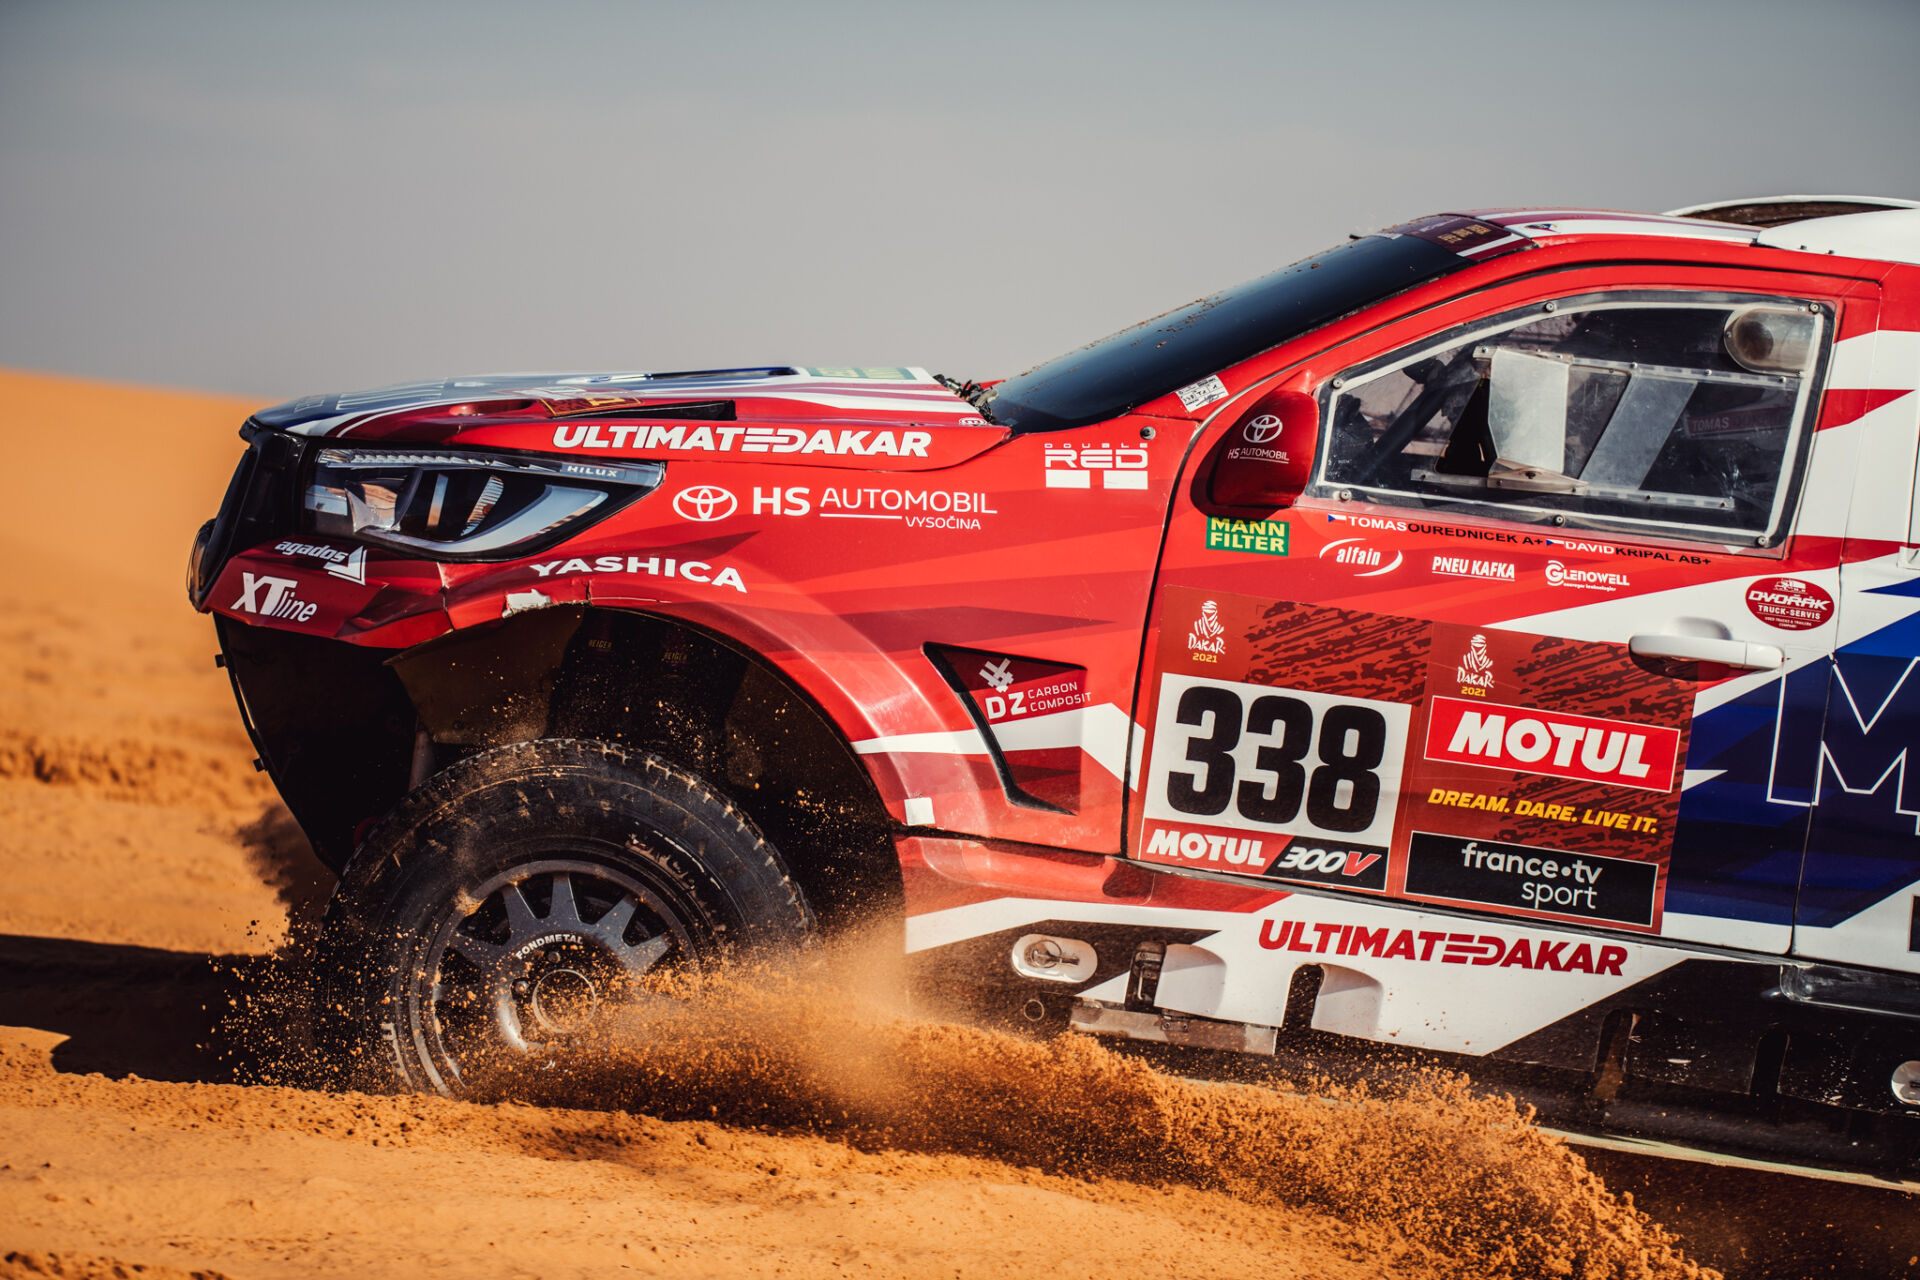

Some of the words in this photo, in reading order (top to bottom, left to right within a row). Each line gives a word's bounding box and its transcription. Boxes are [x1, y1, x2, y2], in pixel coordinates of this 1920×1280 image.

[1045, 449, 1148, 468] RED
[1228, 448, 1240, 459] HS
[1241, 447, 1290, 461] AUTOMOBIL
[567, 465, 618, 477] HILUX
[753, 487, 810, 515] HS
[820, 488, 998, 514] AUTOMOBIL
[905, 515, 981, 530] VYSOČINA
[1211, 517, 1285, 537] MANN
[1210, 532, 1285, 552] FILTER
[1522, 536, 1543, 545] A+
[275, 541, 349, 562] agados
[1336, 546, 1381, 566] alfain
[1679, 555, 1711, 565] AB+
[530, 557, 748, 594] YASHICA
[1432, 556, 1469, 574] PNEU
[1471, 560, 1515, 579] KAFKA
[1545, 562, 1630, 586] GLENOWELL
[230, 572, 318, 622] XTline
[1758, 604, 1821, 620] TRUCK-SERVIS
[1188, 632, 1226, 655] DAKAR
[1192, 652, 1218, 663] 2021
[1457, 666, 1495, 688] DAKAR
[1027, 682, 1078, 699] CARBON
[1461, 686, 1486, 697] 2021
[985, 692, 1027, 719] DZ
[1030, 692, 1092, 712] COMPOSIT
[1448, 711, 1653, 780] MOTUL
[1166, 685, 1387, 833] 338
[1427, 788, 1510, 814] DREAM.
[1515, 799, 1578, 824] DARE.
[1582, 809, 1626, 830] LIVE
[1628, 815, 1658, 834] IT.
[1147, 828, 1267, 869] MOTUL
[1277, 845, 1382, 877] 300V
[1521, 879, 1598, 911] sport
[516, 934, 583, 960] FONDMETAL
